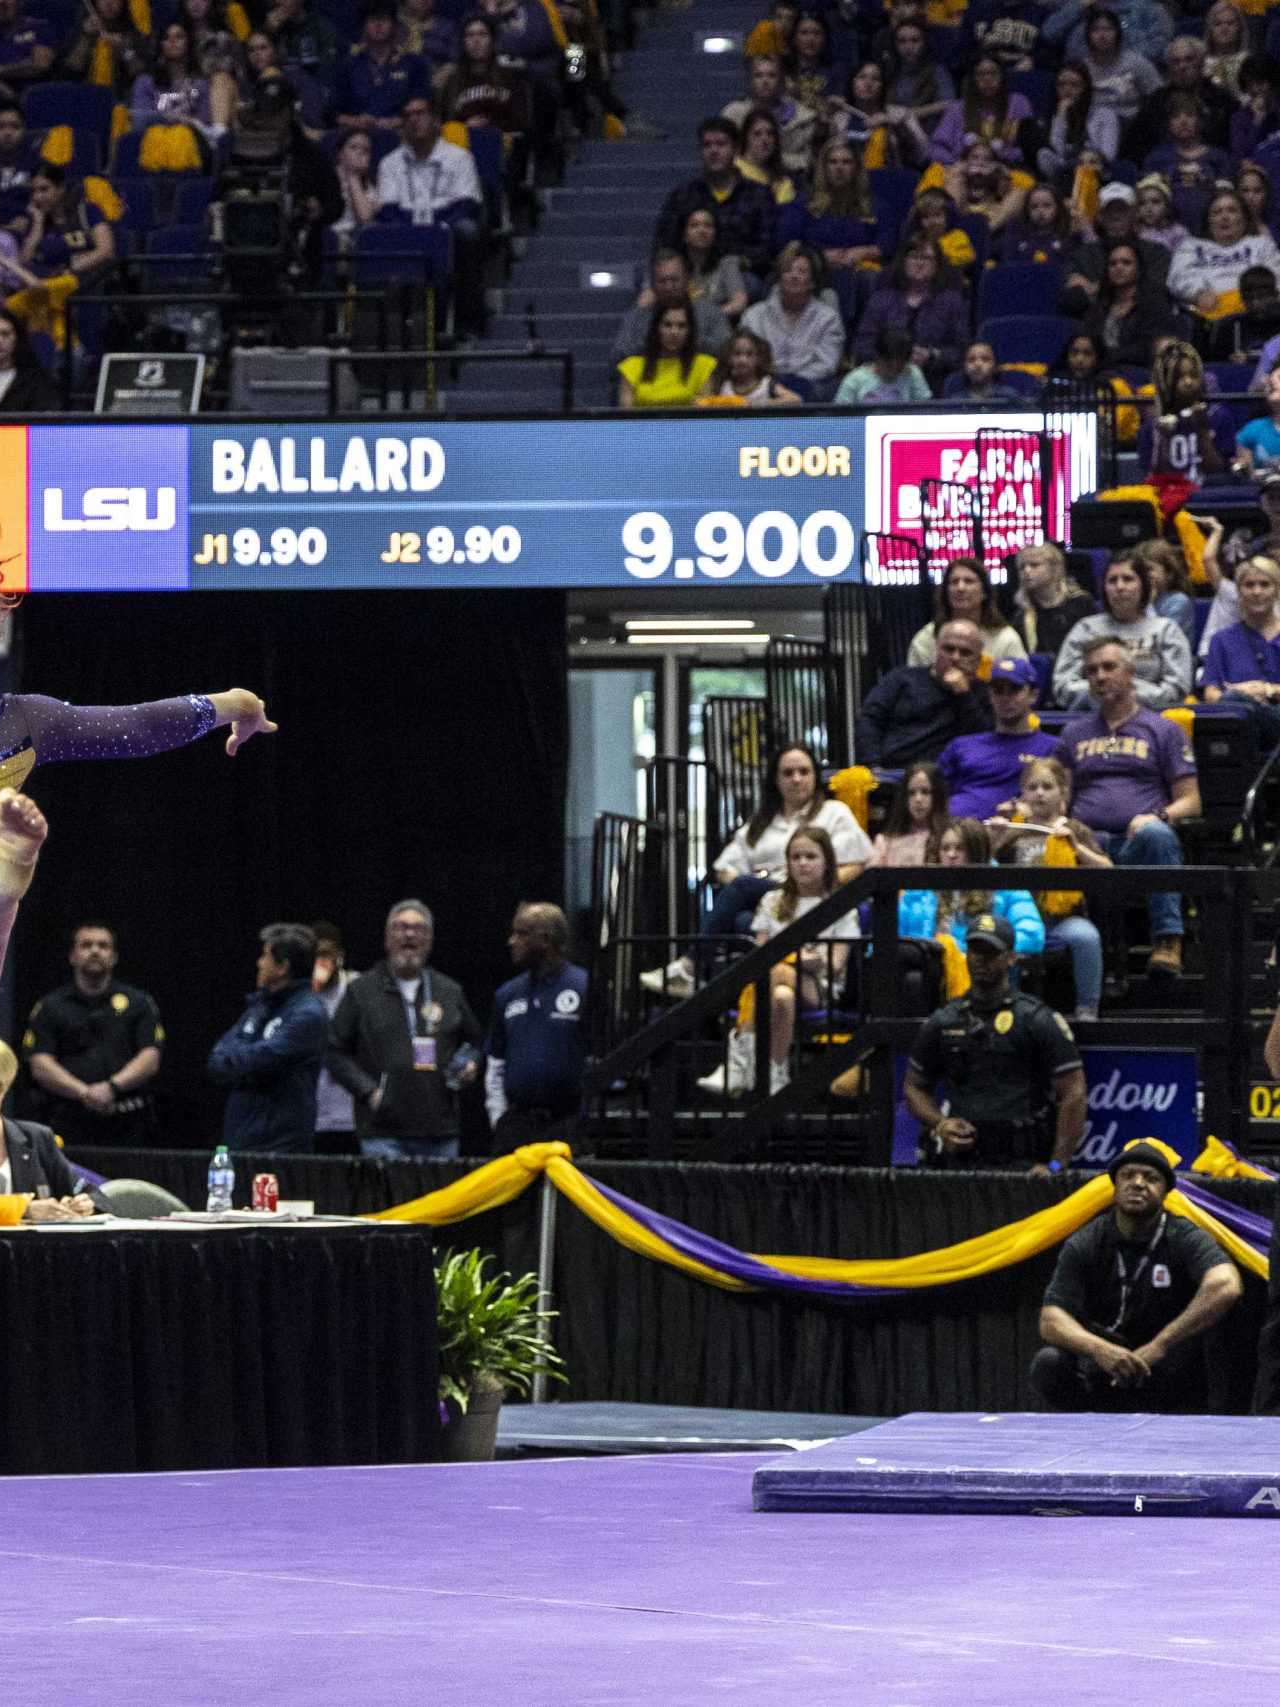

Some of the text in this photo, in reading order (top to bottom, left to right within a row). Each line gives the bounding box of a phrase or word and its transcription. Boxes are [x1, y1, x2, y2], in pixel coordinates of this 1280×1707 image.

[213, 437, 446, 493] BALLARD
[739, 445, 851, 478] FLOOR
[43, 486, 176, 532] LSU
[195, 526, 327, 566] J1 9.90
[381, 525, 522, 564] J2 9.90
[622, 510, 855, 579] 9.900
